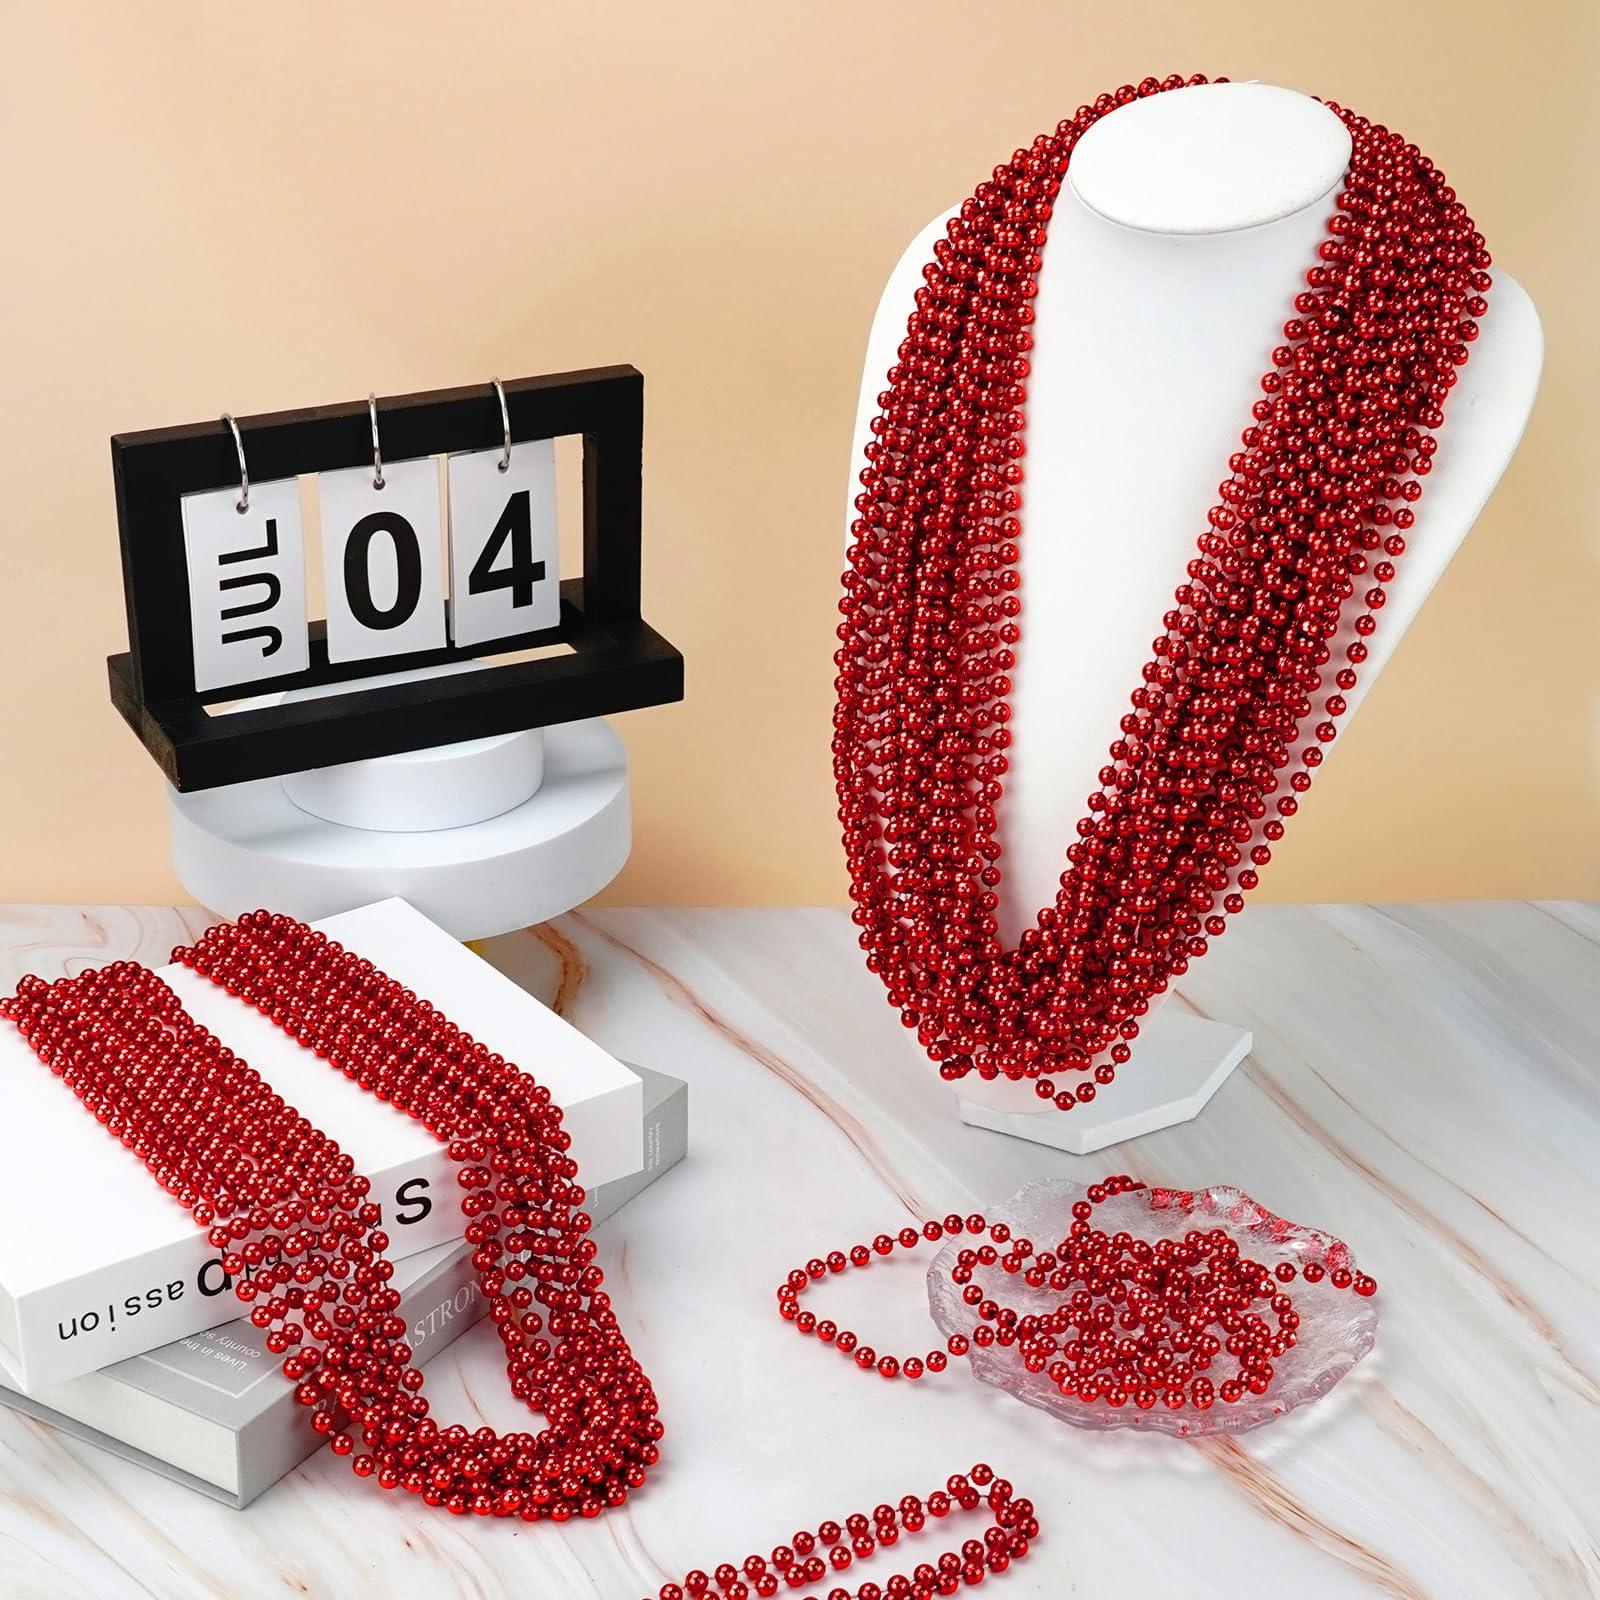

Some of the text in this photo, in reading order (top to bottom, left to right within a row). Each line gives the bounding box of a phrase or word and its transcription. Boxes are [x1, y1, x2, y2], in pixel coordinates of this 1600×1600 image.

[218, 490, 546, 659] JUL 0 4
[179, 1338, 248, 1371] Lives in the
[215, 1335, 262, 1359] country
